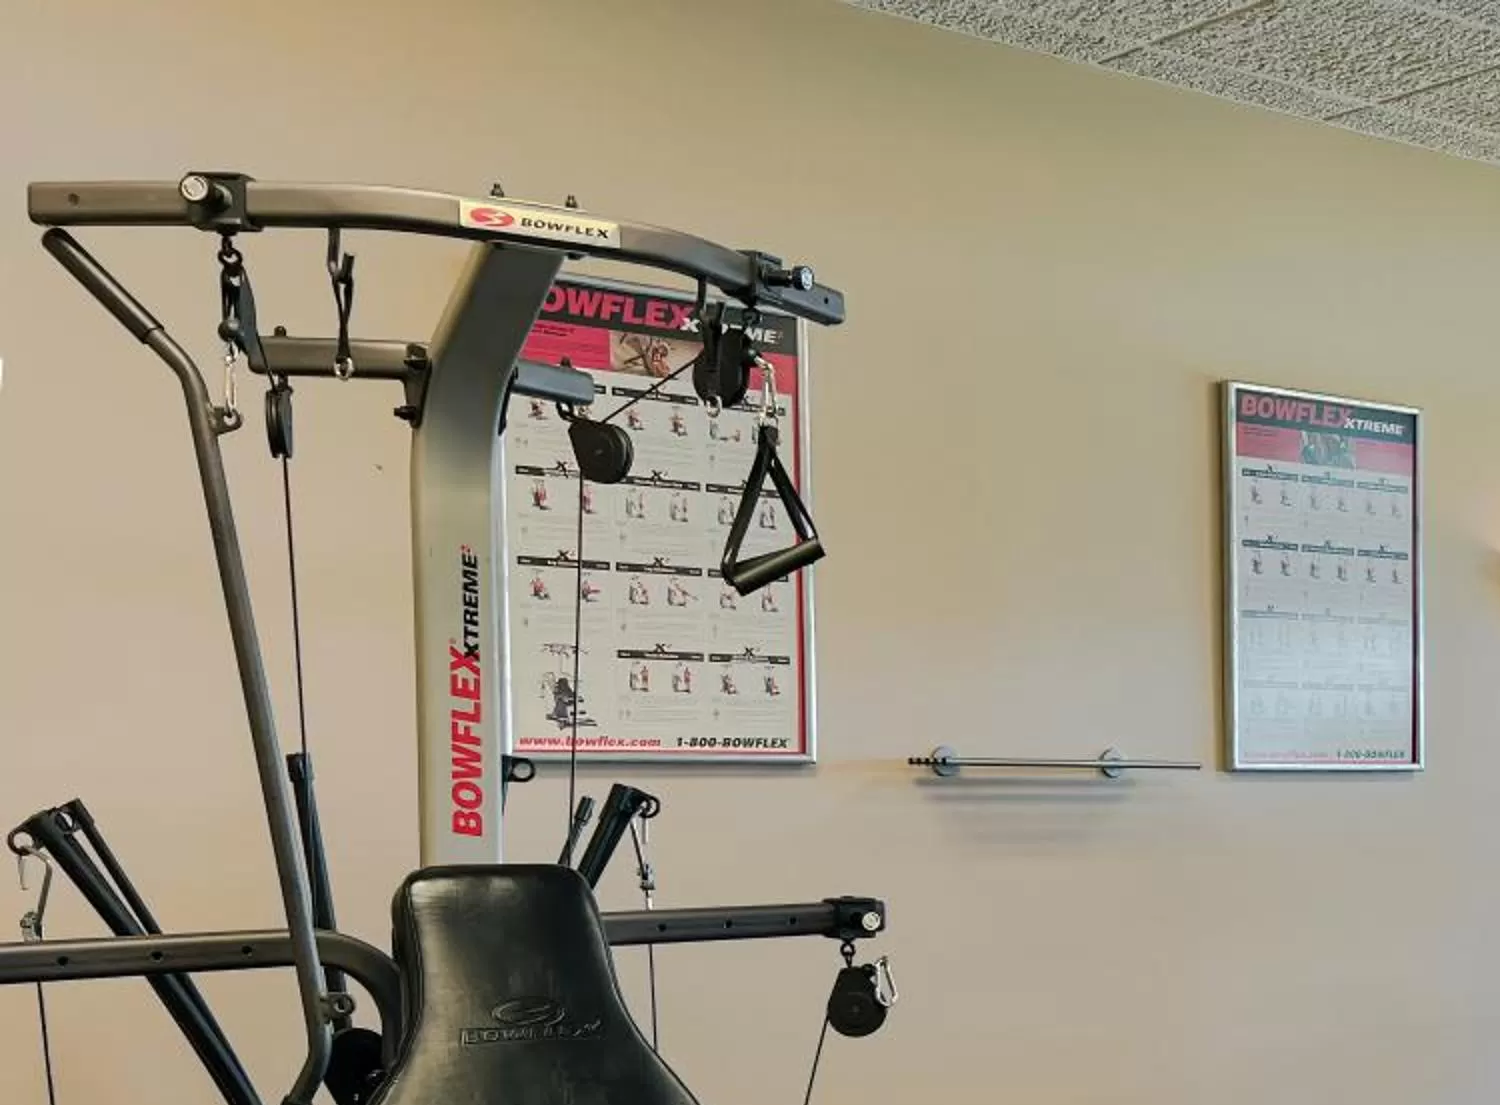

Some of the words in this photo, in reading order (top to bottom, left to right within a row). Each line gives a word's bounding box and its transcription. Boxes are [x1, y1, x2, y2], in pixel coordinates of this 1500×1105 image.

[520, 217, 609, 240] BOWFLEX
[542, 288, 695, 329] OWFLEX
[1241, 394, 1354, 427] BOWFLEX
[1343, 417, 1405, 435] XTREME
[461, 552, 480, 661] XTREME
[450, 638, 483, 837] BOWFLEX
[676, 736, 789, 749] 1-800-BOWFLEX
